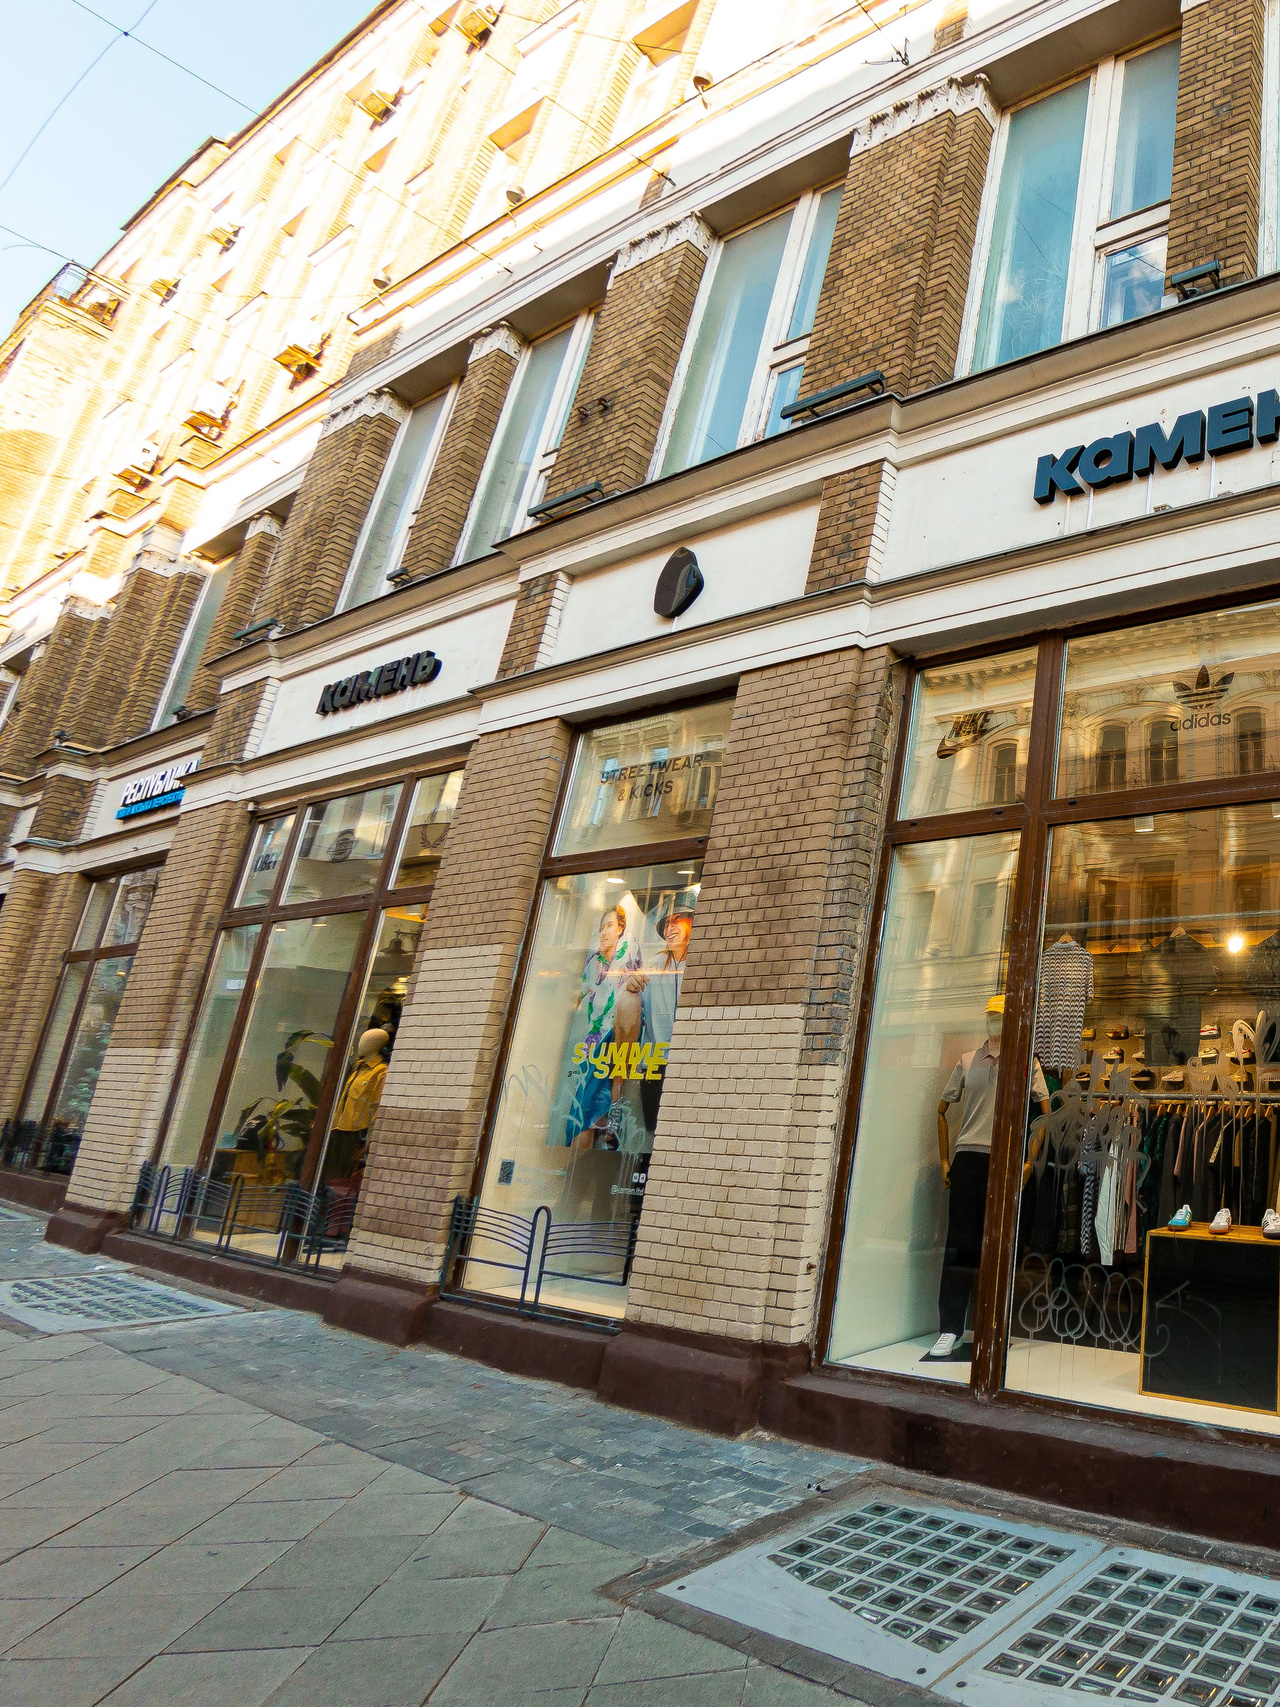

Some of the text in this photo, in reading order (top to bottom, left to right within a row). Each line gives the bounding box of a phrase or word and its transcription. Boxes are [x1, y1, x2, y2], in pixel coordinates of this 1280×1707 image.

[948, 710, 994, 739] NIKE
[1170, 713, 1231, 731] adidas
[600, 754, 703, 783] STREETWEAR
[629, 780, 674, 800] KICKS
[594, 1061, 663, 1080] SALE
